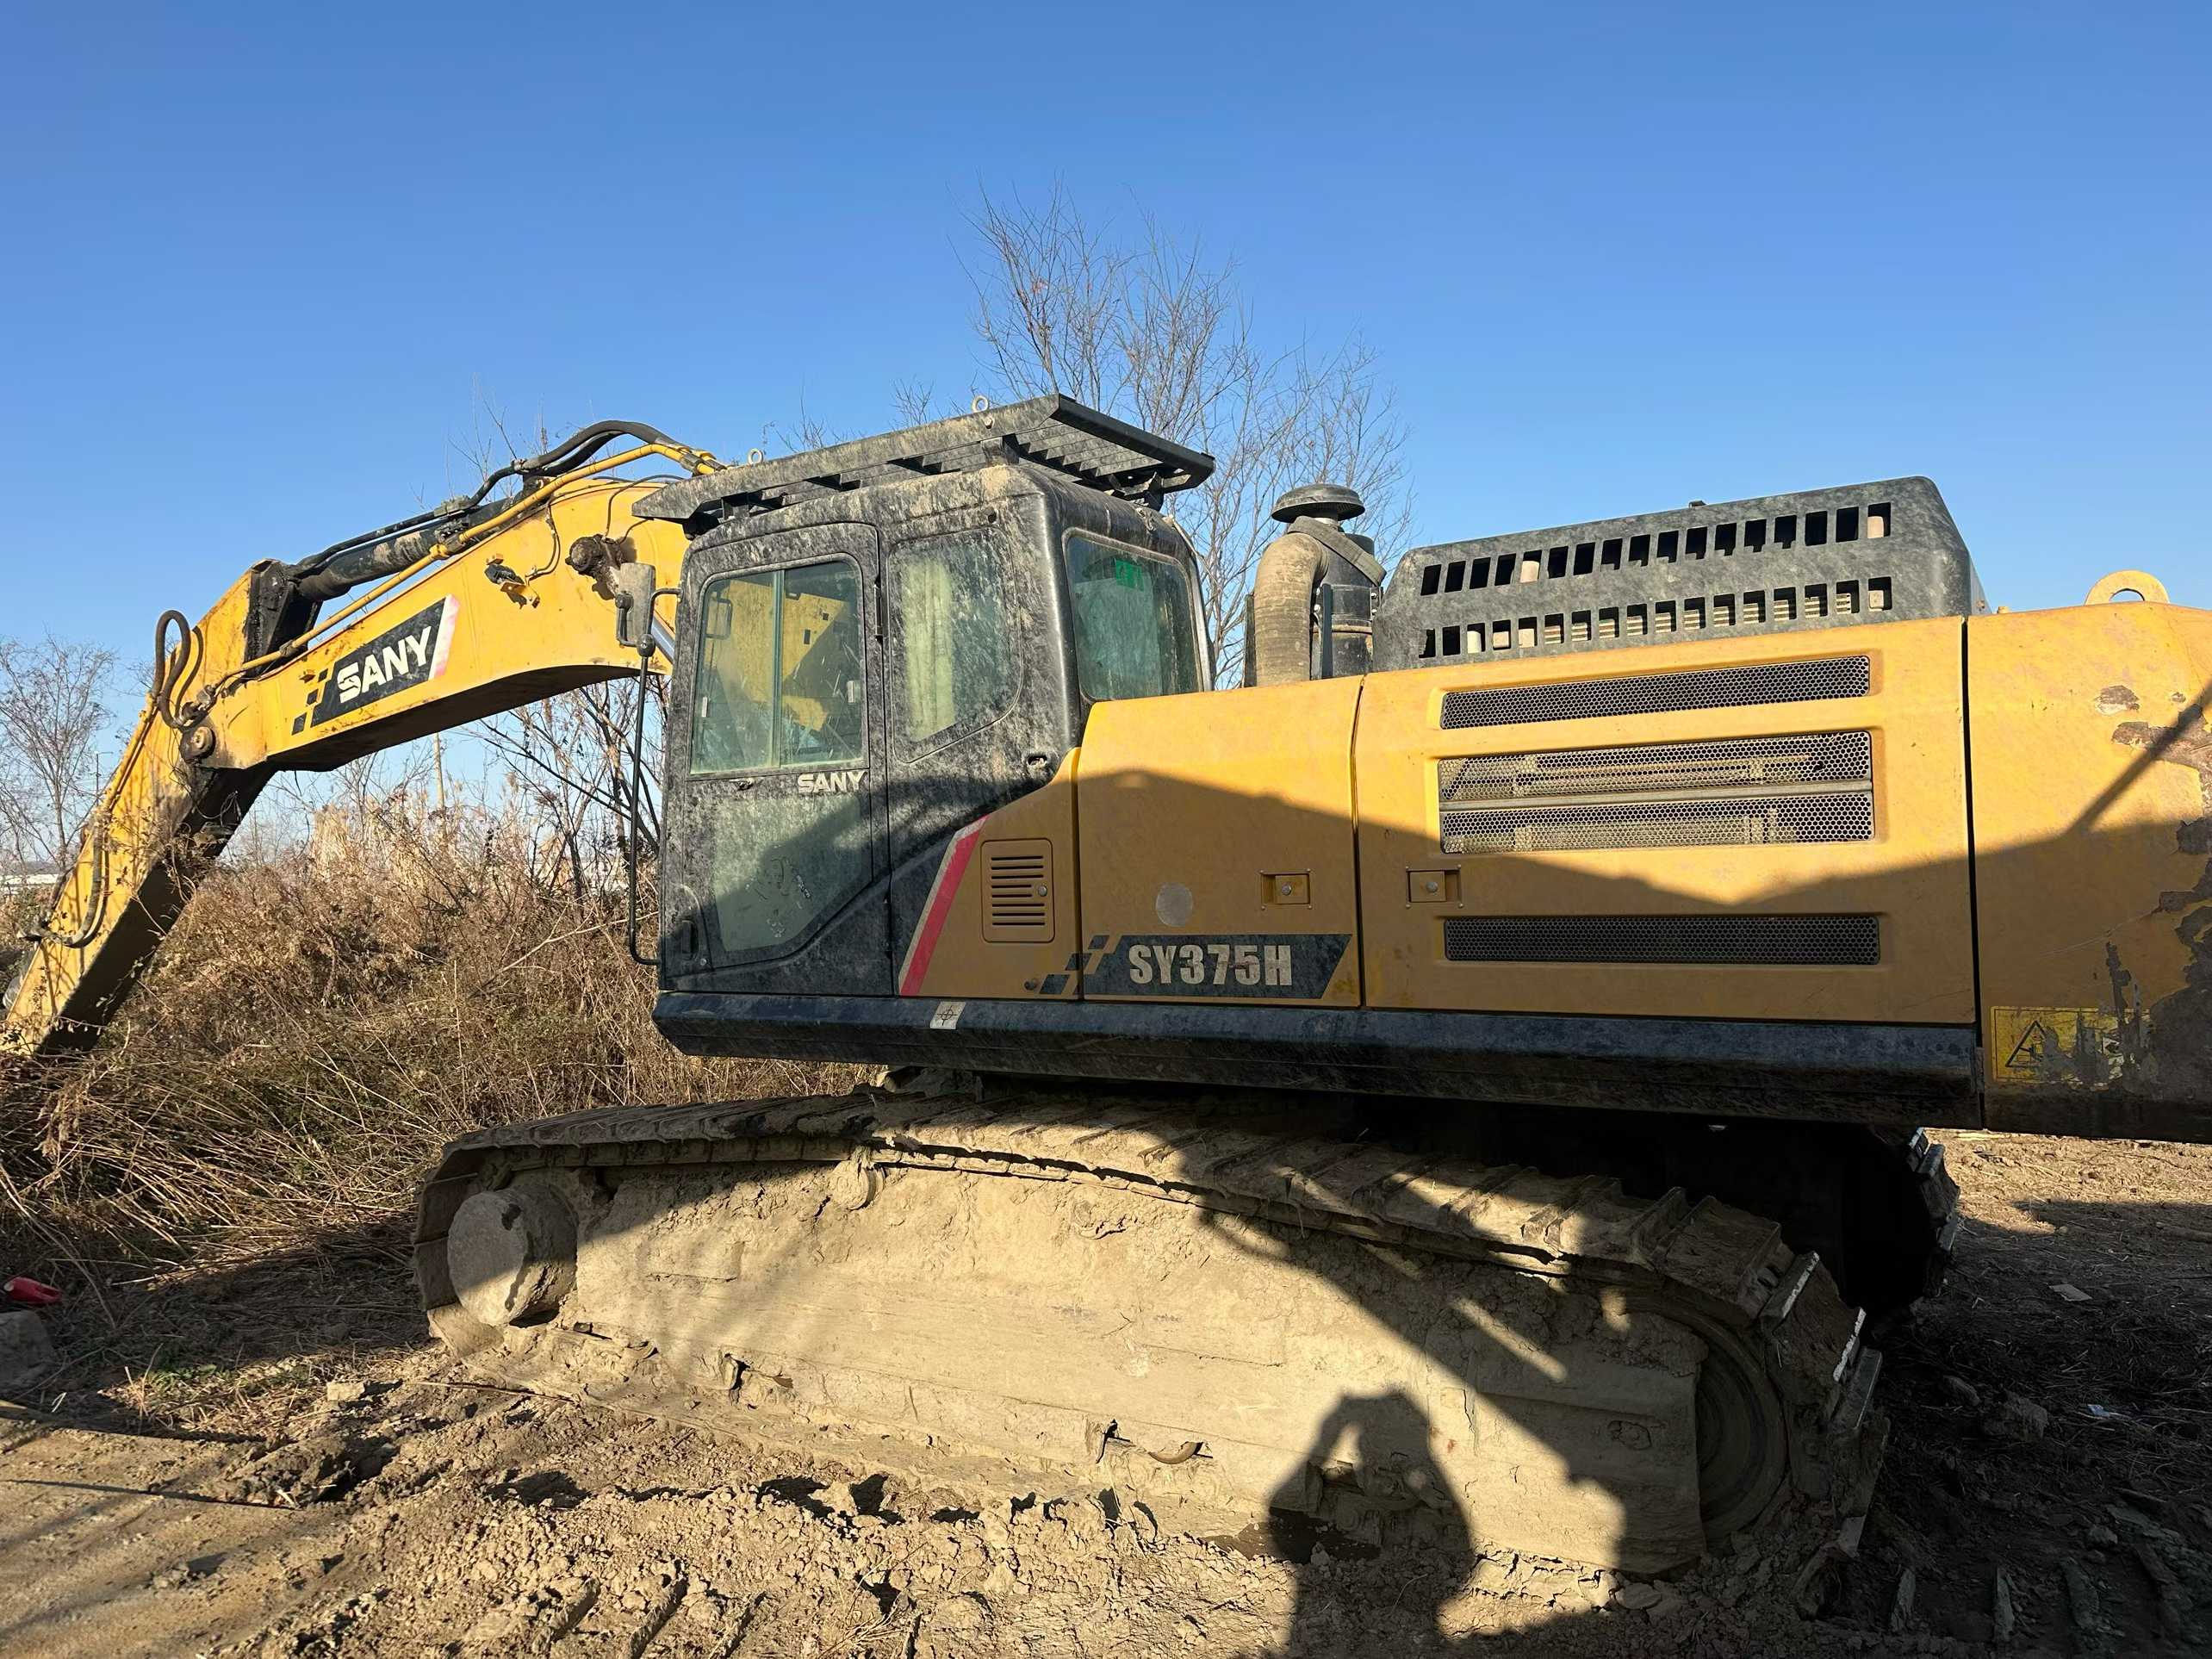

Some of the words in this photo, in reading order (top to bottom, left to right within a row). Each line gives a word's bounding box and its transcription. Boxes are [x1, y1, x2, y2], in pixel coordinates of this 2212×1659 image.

[337, 626, 432, 703] SANY
[798, 771, 865, 793] SANY
[1128, 944, 1292, 986] SY375H
